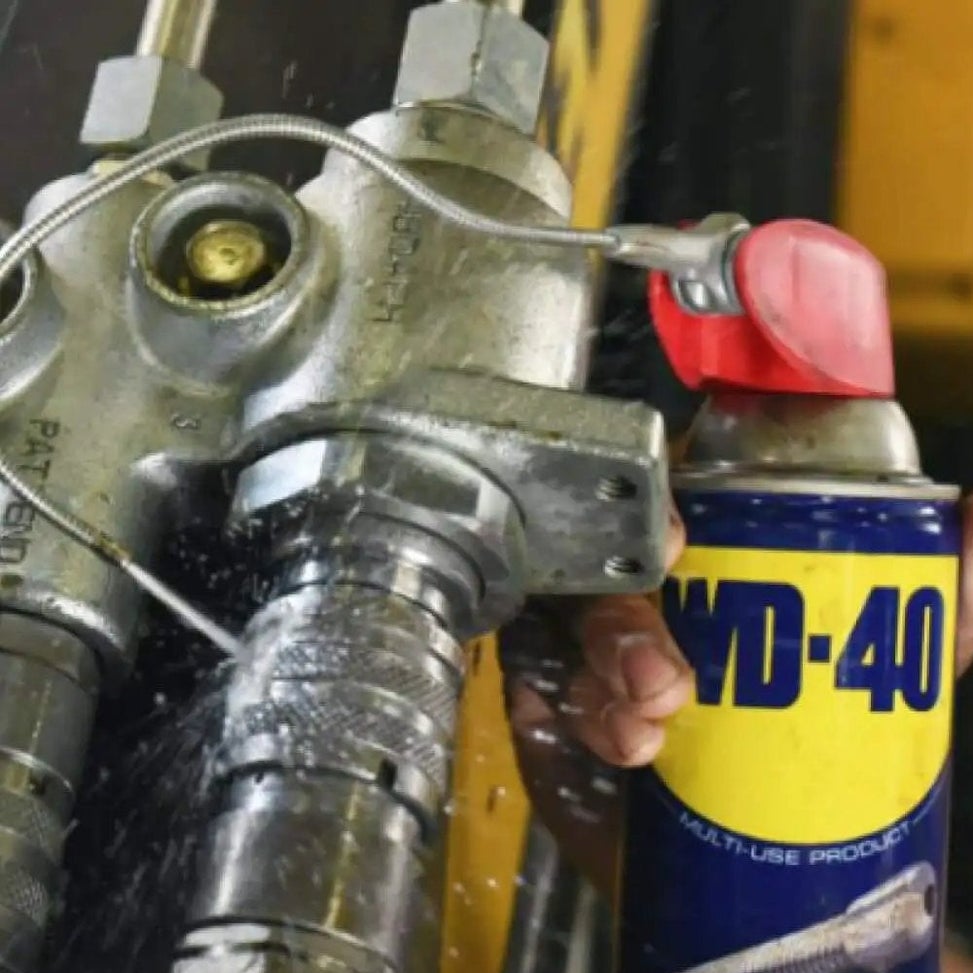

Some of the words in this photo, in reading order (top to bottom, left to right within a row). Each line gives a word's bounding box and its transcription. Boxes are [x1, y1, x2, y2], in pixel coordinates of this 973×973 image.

[662, 576, 945, 712] WD-40
[680, 811, 801, 866] MULTI-USE
[809, 820, 911, 866] PRODUCT
